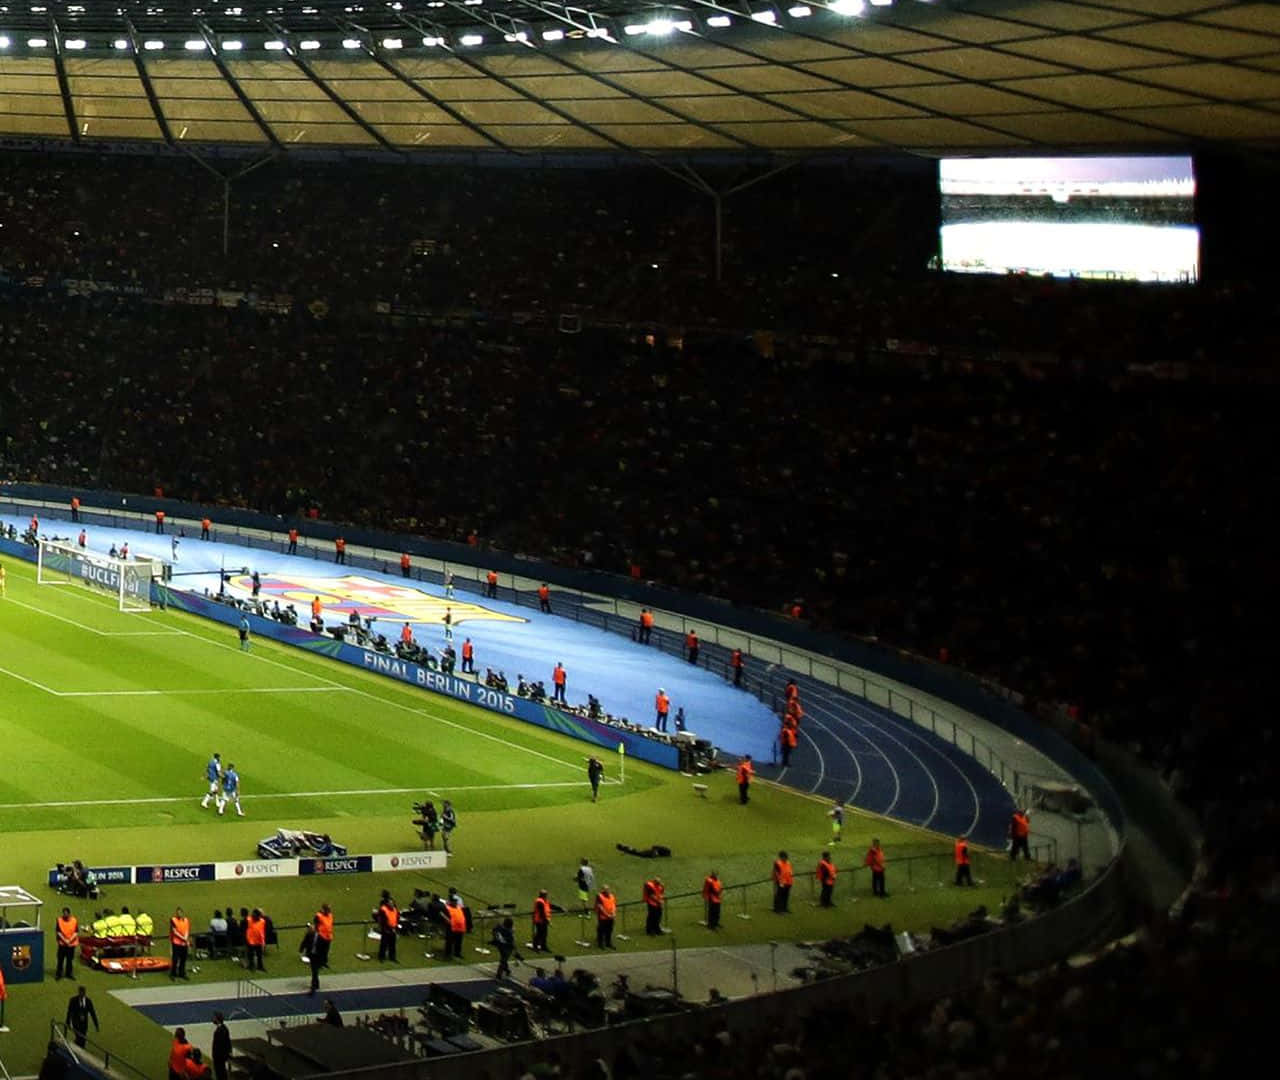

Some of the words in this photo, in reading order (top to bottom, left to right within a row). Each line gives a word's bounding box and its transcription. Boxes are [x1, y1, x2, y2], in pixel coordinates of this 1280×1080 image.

[363, 652, 410, 678] FINAL
[417, 669, 471, 699] BERLIN
[477, 689, 515, 713] 2015
[324, 860, 359, 871] RESPECT
[164, 867, 200, 878] RESPECT
